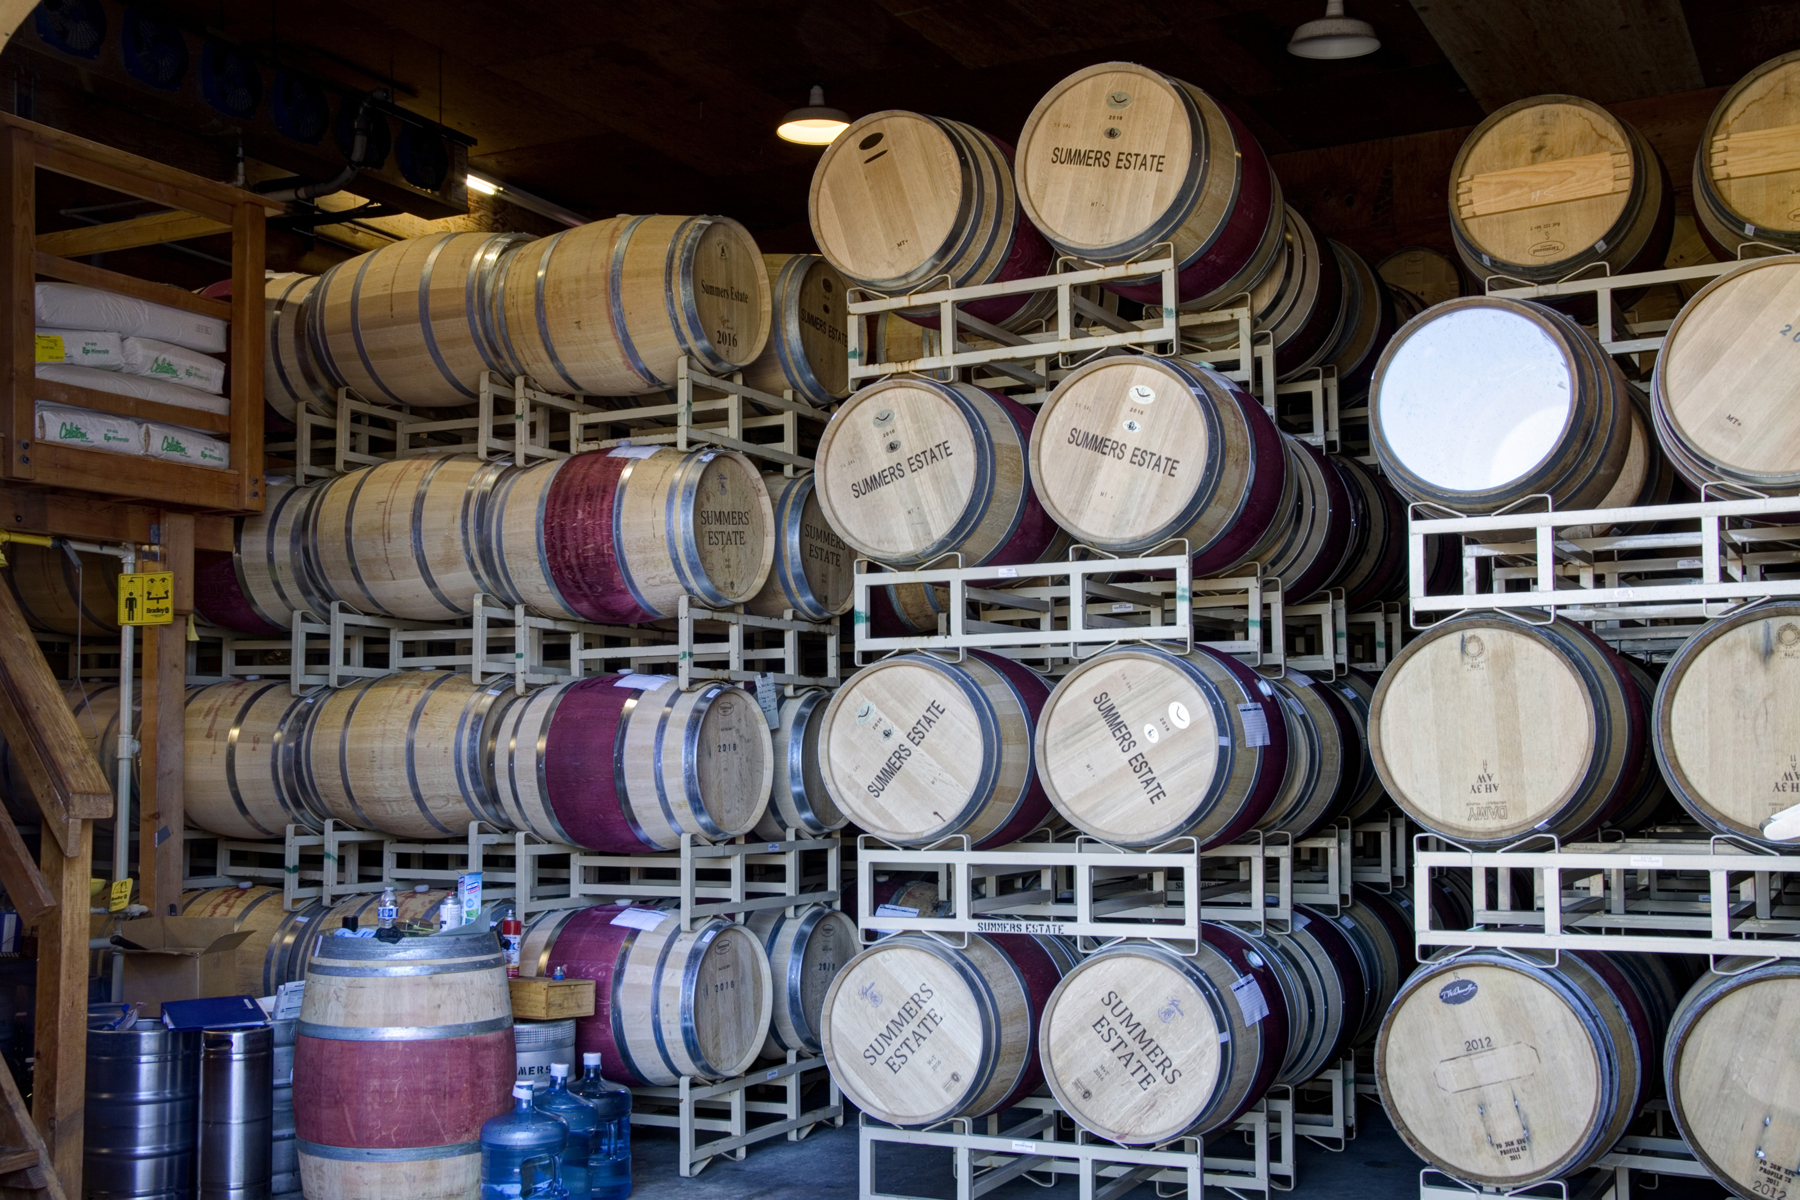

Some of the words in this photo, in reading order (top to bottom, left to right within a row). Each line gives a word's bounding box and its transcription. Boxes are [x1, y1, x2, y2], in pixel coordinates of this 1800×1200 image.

[1051, 147, 1111, 168] SUMMERS
[1115, 152, 1165, 172] ESTATE
[701, 280, 729, 300] Summers
[730, 286, 748, 303] Estate
[717, 331, 738, 347] 2016
[801, 308, 827, 334] SUMMERS
[828, 325, 848, 348] ESTATE
[1067, 428, 1127, 460] SUMMERS
[1129, 447, 1180, 478] ESTATE
[851, 462, 905, 498] SUMMERS
[907, 440, 953, 473] ESTATE
[701, 511, 749, 525] SUMMERS
[708, 531, 745, 545] ESTATE
[805, 524, 845, 550] SUMMERS
[809, 544, 841, 567] ESTATE
[867, 744, 912, 798] SUMMERS
[906, 700, 946, 747] ESTATE
[1093, 692, 1137, 753] SUMMERS
[1128, 752, 1167, 805] ESTATE
[1476, 773, 1494, 783] AW
[1484, 783, 1499, 793] AH
[1467, 805, 1507, 821] DAMY
[977, 922, 1022, 933] SUMMERS
[1026, 923, 1065, 935] ESTATE
[863, 983, 934, 1066] SUMMERS
[885, 1008, 943, 1075] ESTATE
[1101, 990, 1182, 1085] SUMMERS
[1465, 1036, 1493, 1052] 2012
[1092, 1015, 1157, 1091] ESTATE
[1759, 1166, 1783, 1180] PROFILE
[1752, 1180, 1787, 1200] 2012
